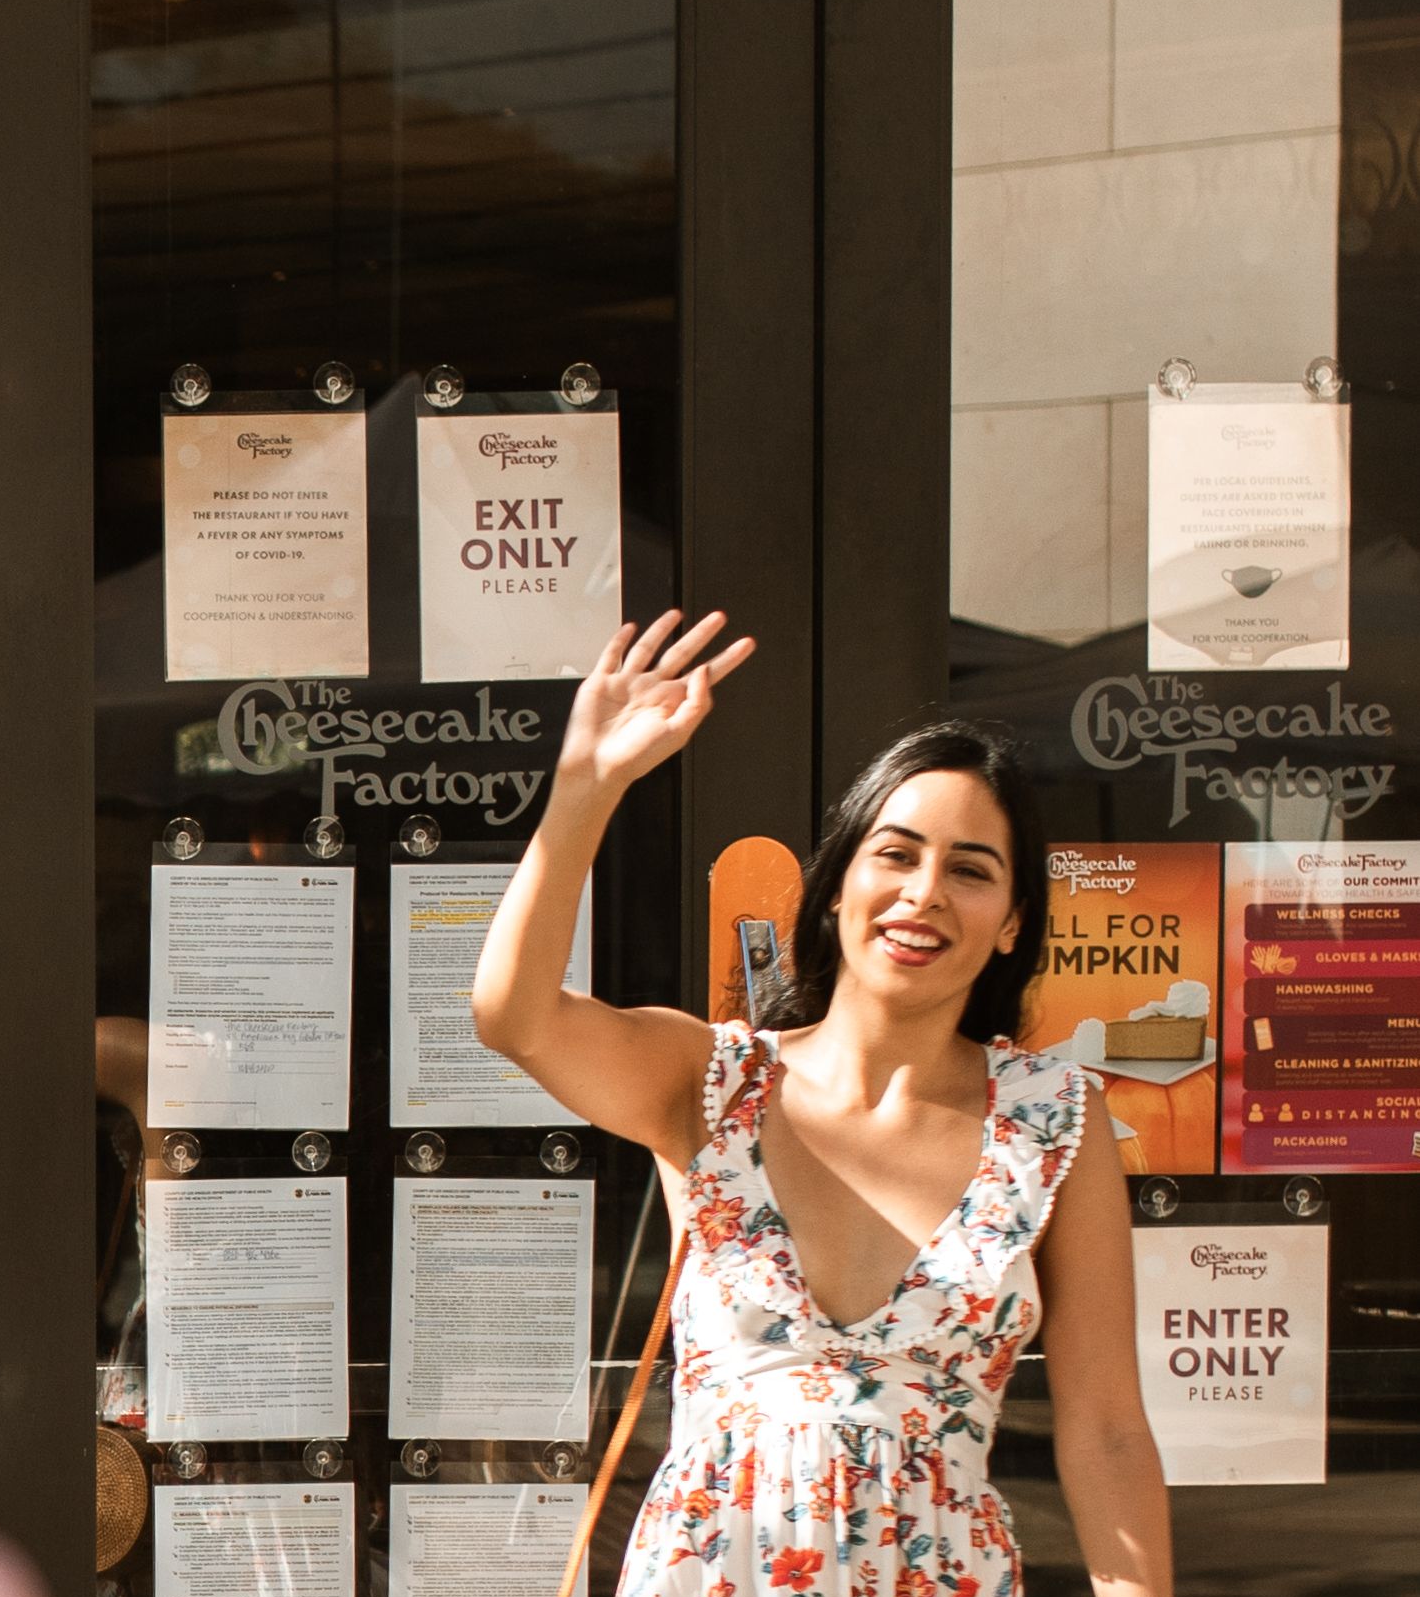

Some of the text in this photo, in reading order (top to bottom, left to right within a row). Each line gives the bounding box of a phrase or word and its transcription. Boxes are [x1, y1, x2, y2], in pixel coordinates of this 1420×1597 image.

[237, 434, 292, 450] Cheesecake
[479, 434, 557, 456] Cheesecake
[252, 445, 292, 459] Factory
[496, 450, 557, 471] Factory
[1193, 477, 1211, 485] PER
[1215, 477, 1246, 485] LOCAL
[253, 492, 268, 500] DO
[1297, 492, 1326, 500] WEAR
[214, 512, 280, 520] RESTAURANT
[476, 498, 563, 531] EXIT
[1202, 509, 1224, 517] FACE
[1293, 508, 1303, 516] IN
[260, 531, 282, 539] ANY
[1234, 540, 1249, 548] OR
[236, 551, 305, 559] OF COVID-19.
[461, 537, 578, 570] ONLY
[483, 578, 557, 594] PLEASE
[215, 594, 248, 602] THANK
[252, 594, 273, 602] YOU
[277, 594, 295, 602] FOR
[184, 612, 255, 621] COOPERATION
[1225, 618, 1279, 627] THANK YOU
[1193, 635, 1211, 643] FOR
[1214, 635, 1238, 643] YOUR
[294, 680, 352, 710] The
[1147, 675, 1205, 705] The
[217, 679, 542, 775] Cheesecake
[1071, 674, 1393, 770] Cheesecake
[289, 743, 545, 831] Factory
[1141, 738, 1395, 828] Factory
[1067, 850, 1083, 860] The
[1048, 852, 1137, 879] Cheesecake
[1298, 854, 1360, 873] Cheesecake
[1063, 871, 1136, 896] Factory
[1344, 877, 1368, 886] OUR
[1277, 909, 1399, 920] WELLNESS CHECKS
[1049, 915, 1180, 938] LL FOR
[1316, 953, 1365, 962] GLOVES
[1370, 953, 1377, 962] &
[1276, 984, 1374, 994] HANDWASHING
[1275, 1059, 1338, 1069] CLEANING
[1343, 1059, 1350, 1068] &
[1274, 1137, 1347, 1146] PACKAGING
[1191, 1245, 1267, 1267] Cheesecake
[1207, 1261, 1267, 1281] Factory
[1164, 1308, 1290, 1339] ENTER
[1169, 1347, 1284, 1377] ONLY
[1189, 1386, 1263, 1400] PLEASE
